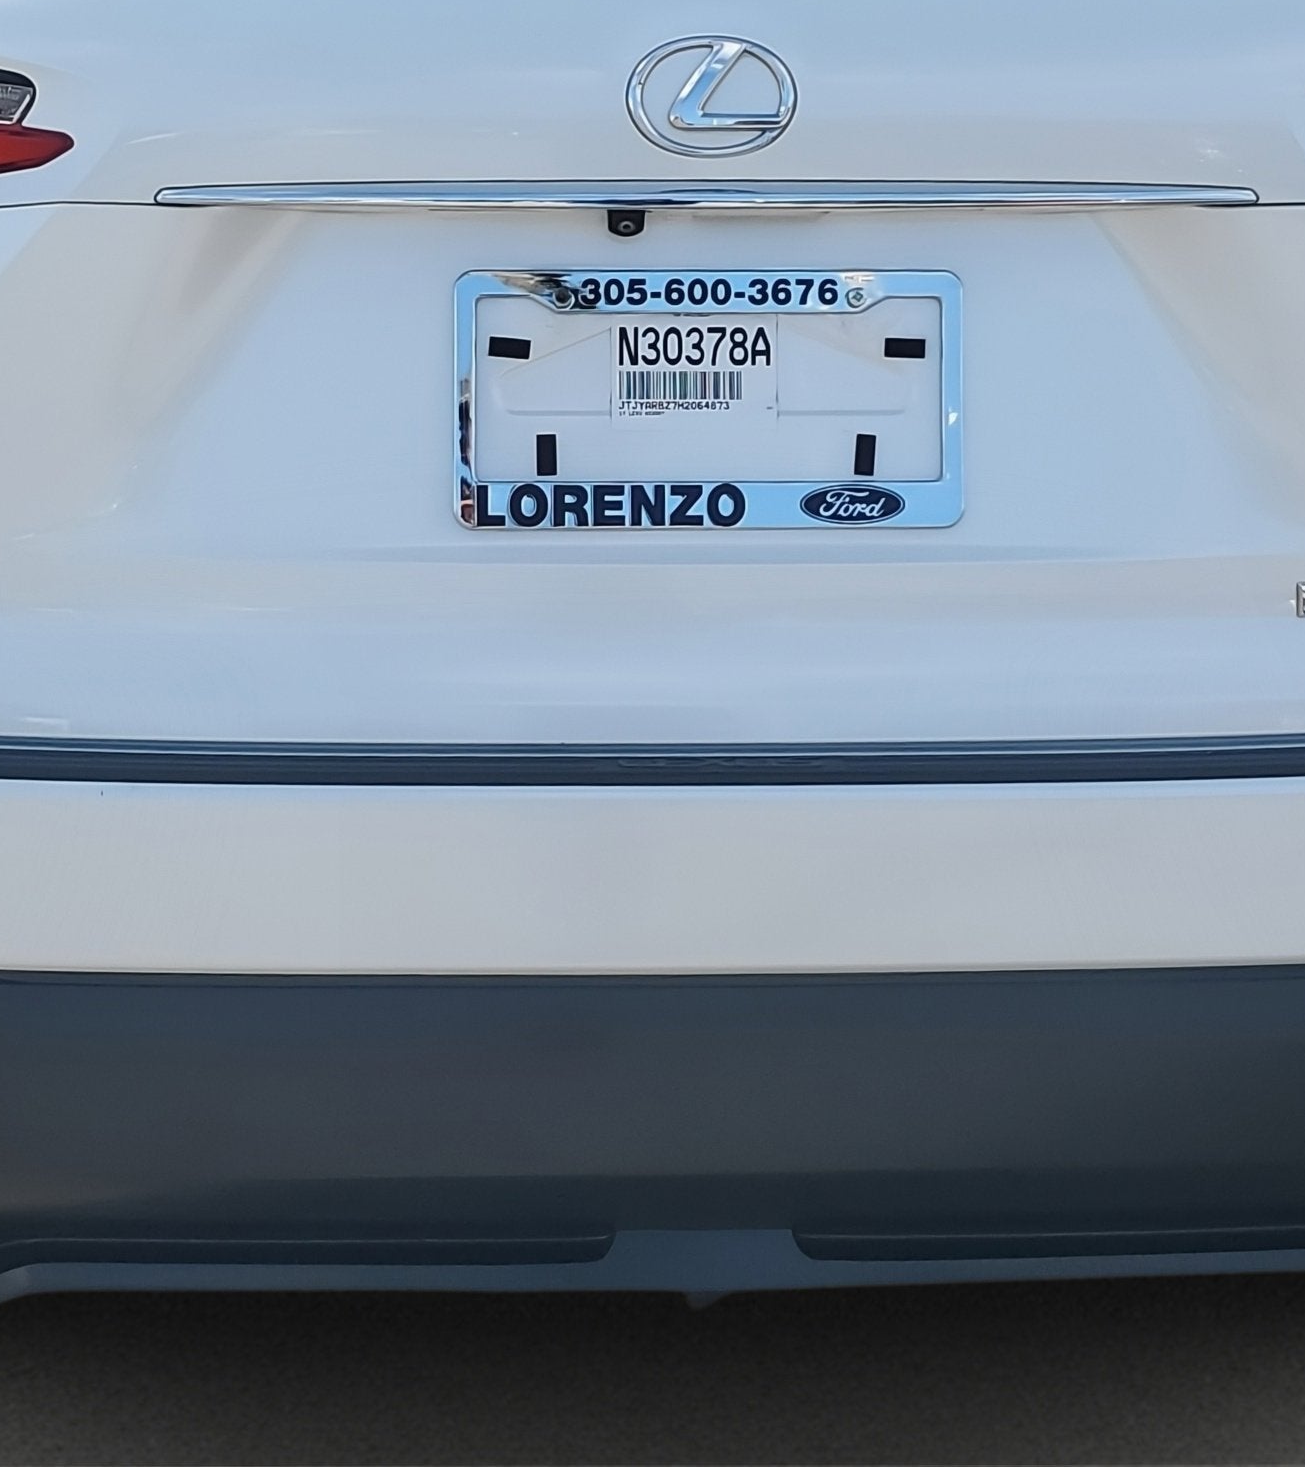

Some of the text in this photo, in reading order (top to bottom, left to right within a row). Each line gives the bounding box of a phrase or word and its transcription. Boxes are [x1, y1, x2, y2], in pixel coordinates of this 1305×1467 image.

[580, 278, 839, 307] 305-600-3676
[618, 326, 772, 367] N30378A
[476, 483, 746, 528] LORENZO
[820, 492, 886, 518] Ford
